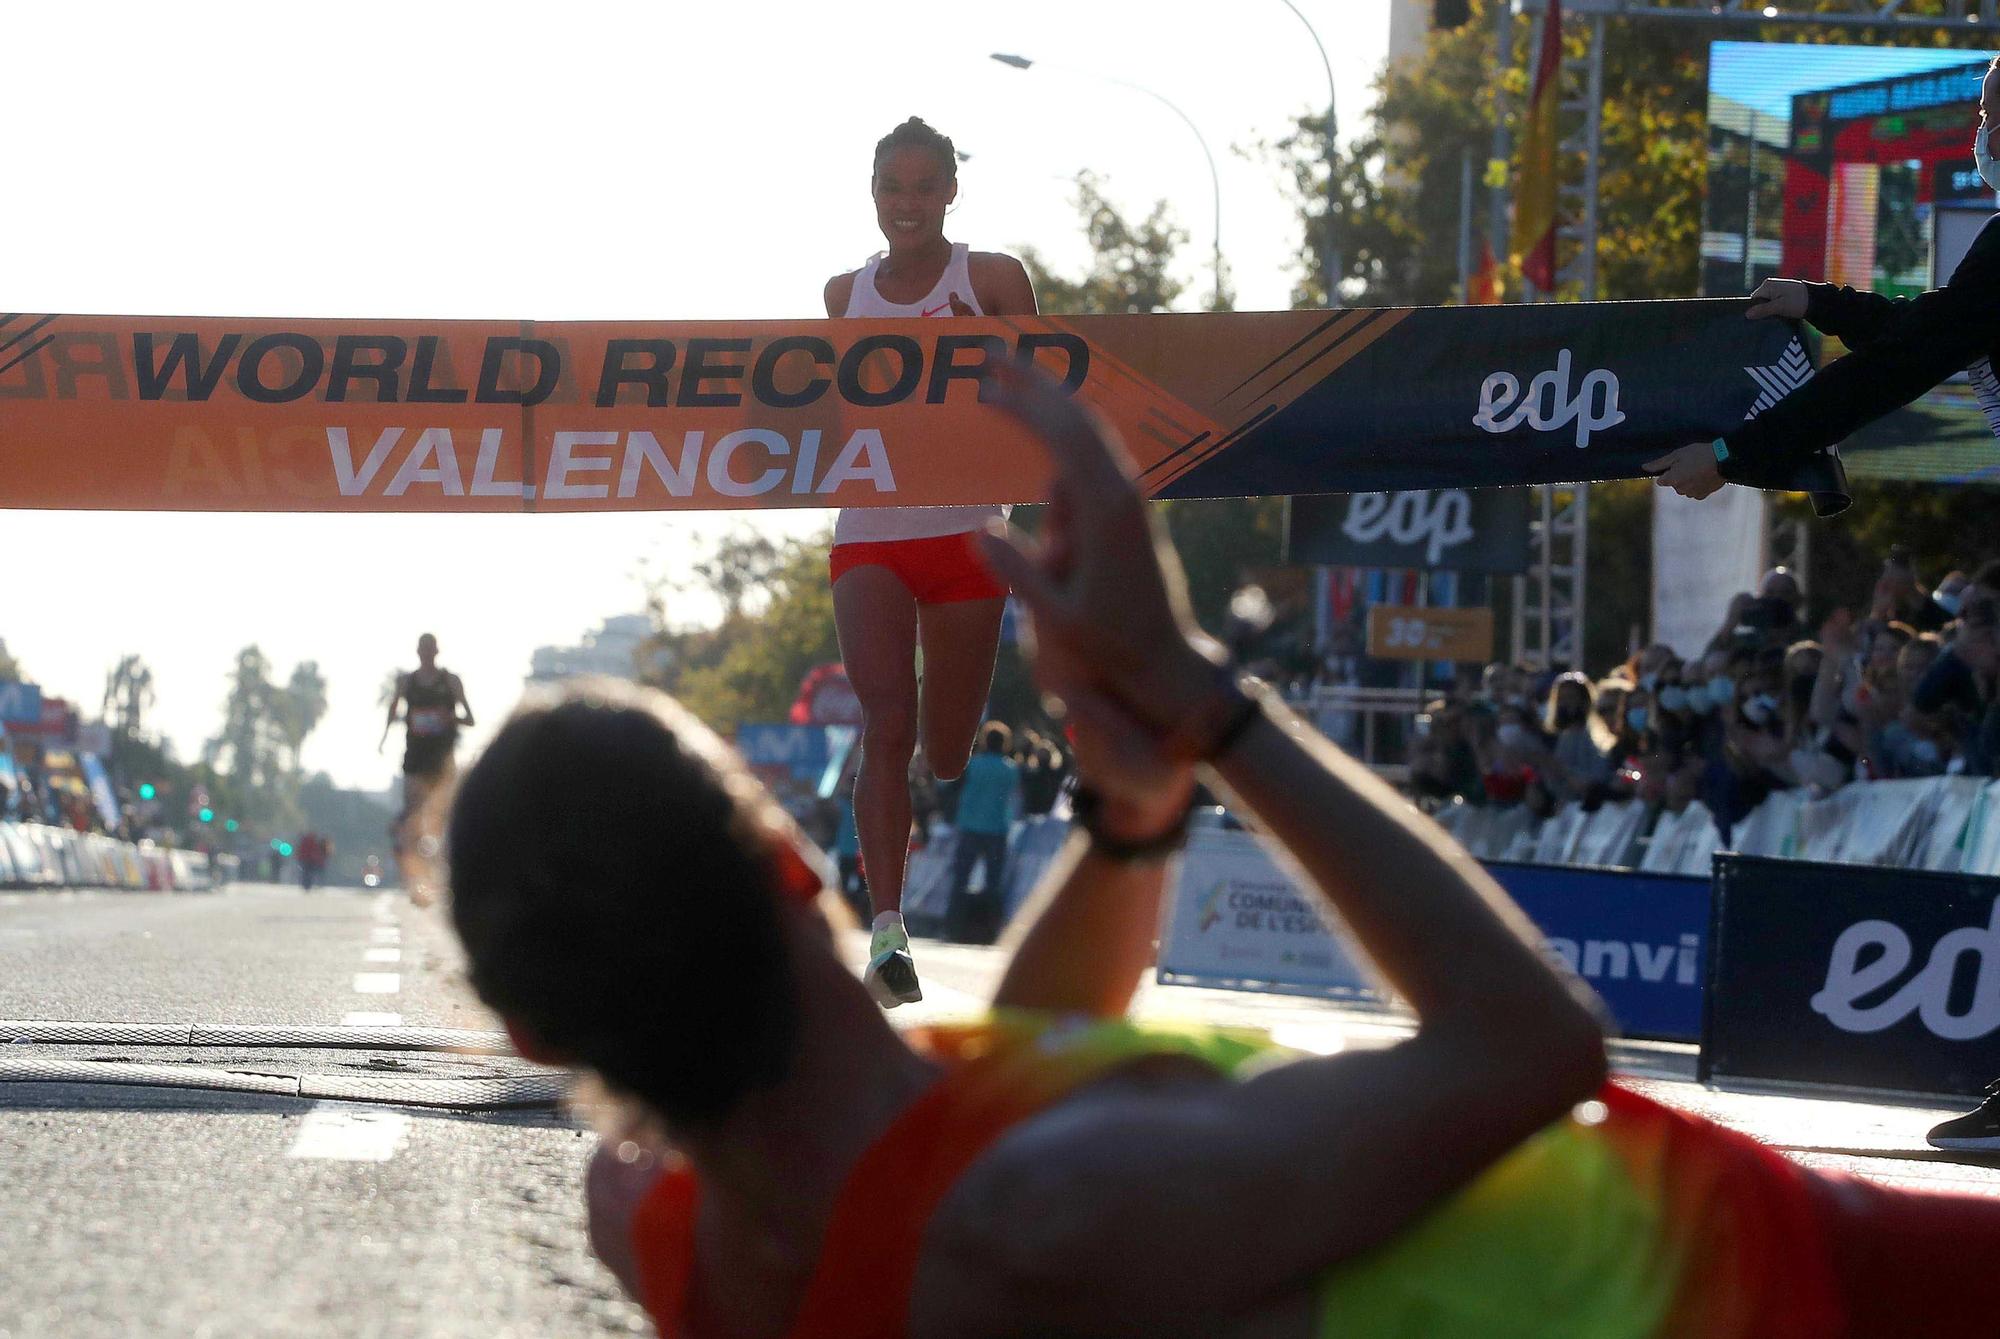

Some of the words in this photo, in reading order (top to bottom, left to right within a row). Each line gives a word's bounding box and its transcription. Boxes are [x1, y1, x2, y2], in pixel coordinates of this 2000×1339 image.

[133, 331, 561, 408] WORLD
[594, 333, 1090, 409] RECORD
[1472, 348, 1627, 449] edp
[325, 425, 897, 500] VALENCIA
